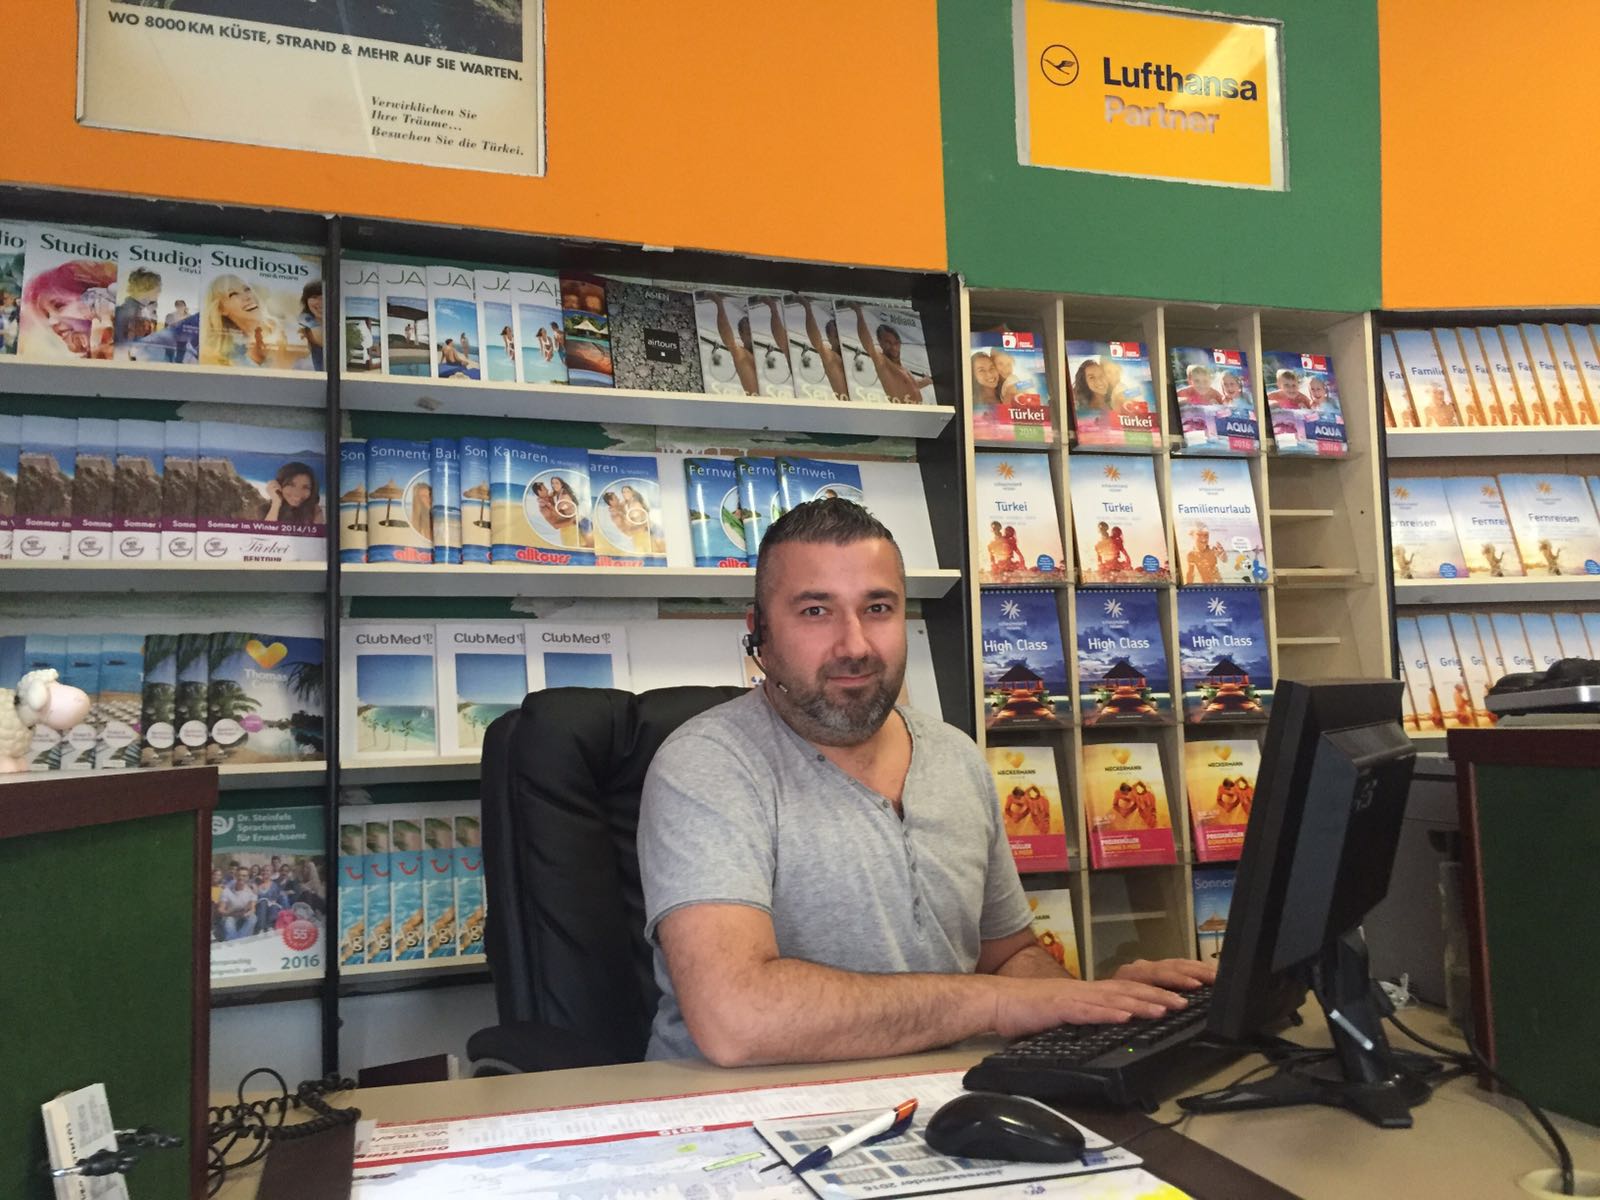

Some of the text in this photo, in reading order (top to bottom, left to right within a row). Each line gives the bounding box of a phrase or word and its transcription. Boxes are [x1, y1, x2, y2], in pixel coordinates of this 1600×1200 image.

[107, 10, 140, 27] WO
[219, 22, 272, 44] KÜSTE,
[275, 33, 337, 55] STRAND
[341, 41, 354, 56] &
[357, 45, 400, 63] MEHR
[403, 51, 432, 68] AUF
[435, 56, 457, 72] SIE
[459, 60, 524, 82] WARTEN.
[1103, 56, 1258, 101] Lufthansa
[370, 95, 478, 121] Verwirklichen Sie
[1104, 94, 1220, 135] Partner
[370, 109, 463, 132] Ihre Träume...
[370, 125, 525, 157] Besuchen Sie die Türkei.
[211, 250, 310, 277] Studiosus
[386, 269, 425, 286] JA
[647, 337, 678, 351] airtours
[1007, 407, 1045, 421] Türkei
[1117, 414, 1153, 428] Türkei
[1226, 421, 1255, 434] AQUA
[1314, 424, 1342, 437] AQUA
[370, 445, 431, 460] Sonnent
[464, 444, 488, 458] Son
[493, 445, 549, 464] Kanaren
[590, 463, 619, 474] aren
[780, 463, 836, 481] Fernweh
[994, 500, 1028, 513] Türkei
[1102, 502, 1134, 514] Türkei
[1178, 503, 1251, 515] Familienurlaub
[1528, 512, 1580, 524] Fernreisen
[207, 519, 318, 534] Sommer im Winter 2014/15
[515, 547, 571, 564] alltours
[984, 638, 1048, 653] High Class
[1088, 636, 1150, 651] High Class
[1192, 634, 1253, 649] High Class
[281, 954, 320, 970] 2016
